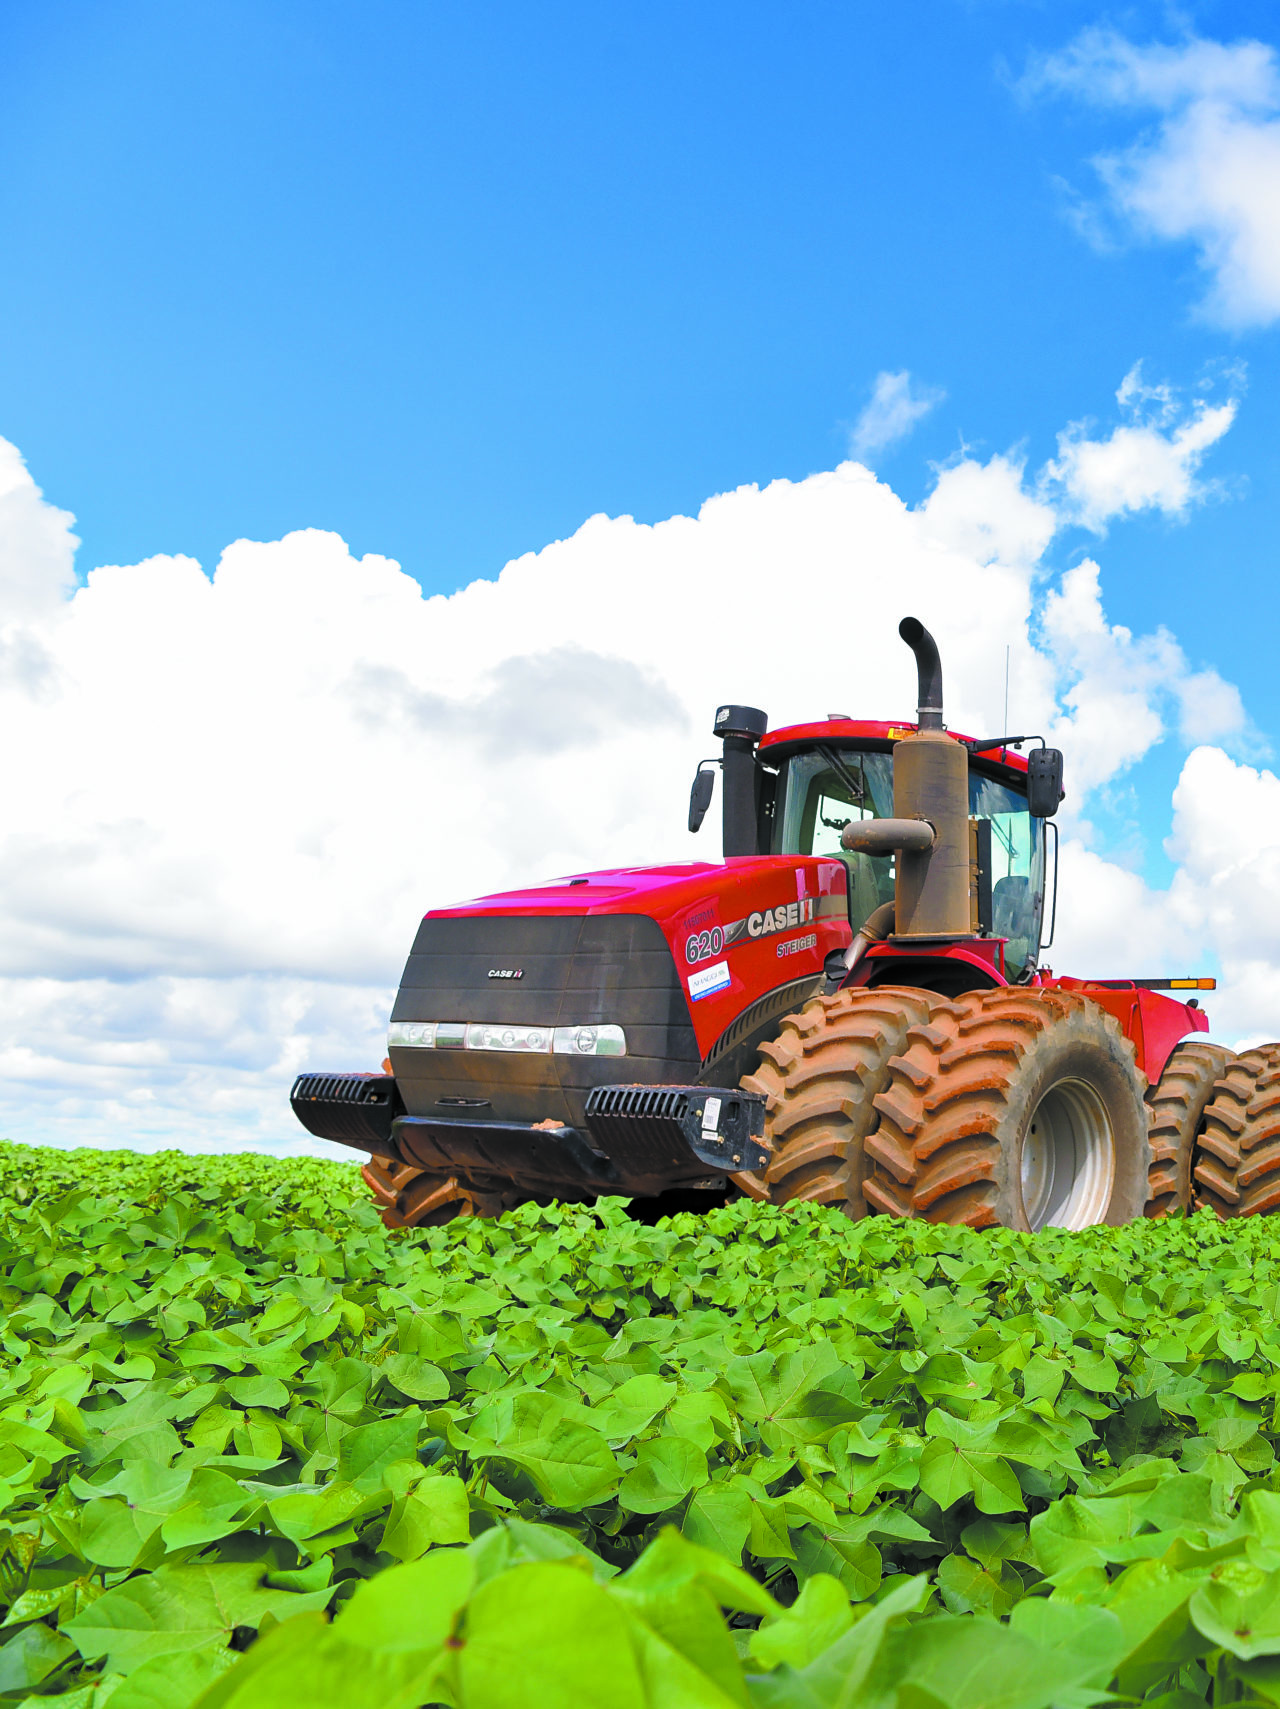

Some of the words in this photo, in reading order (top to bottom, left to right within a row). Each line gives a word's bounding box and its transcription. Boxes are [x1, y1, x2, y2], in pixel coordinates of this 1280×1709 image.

[747, 902, 798, 937] CASE
[685, 926, 723, 965] 620
[777, 933, 817, 958] STEIGER
[488, 969, 513, 978] CASE
